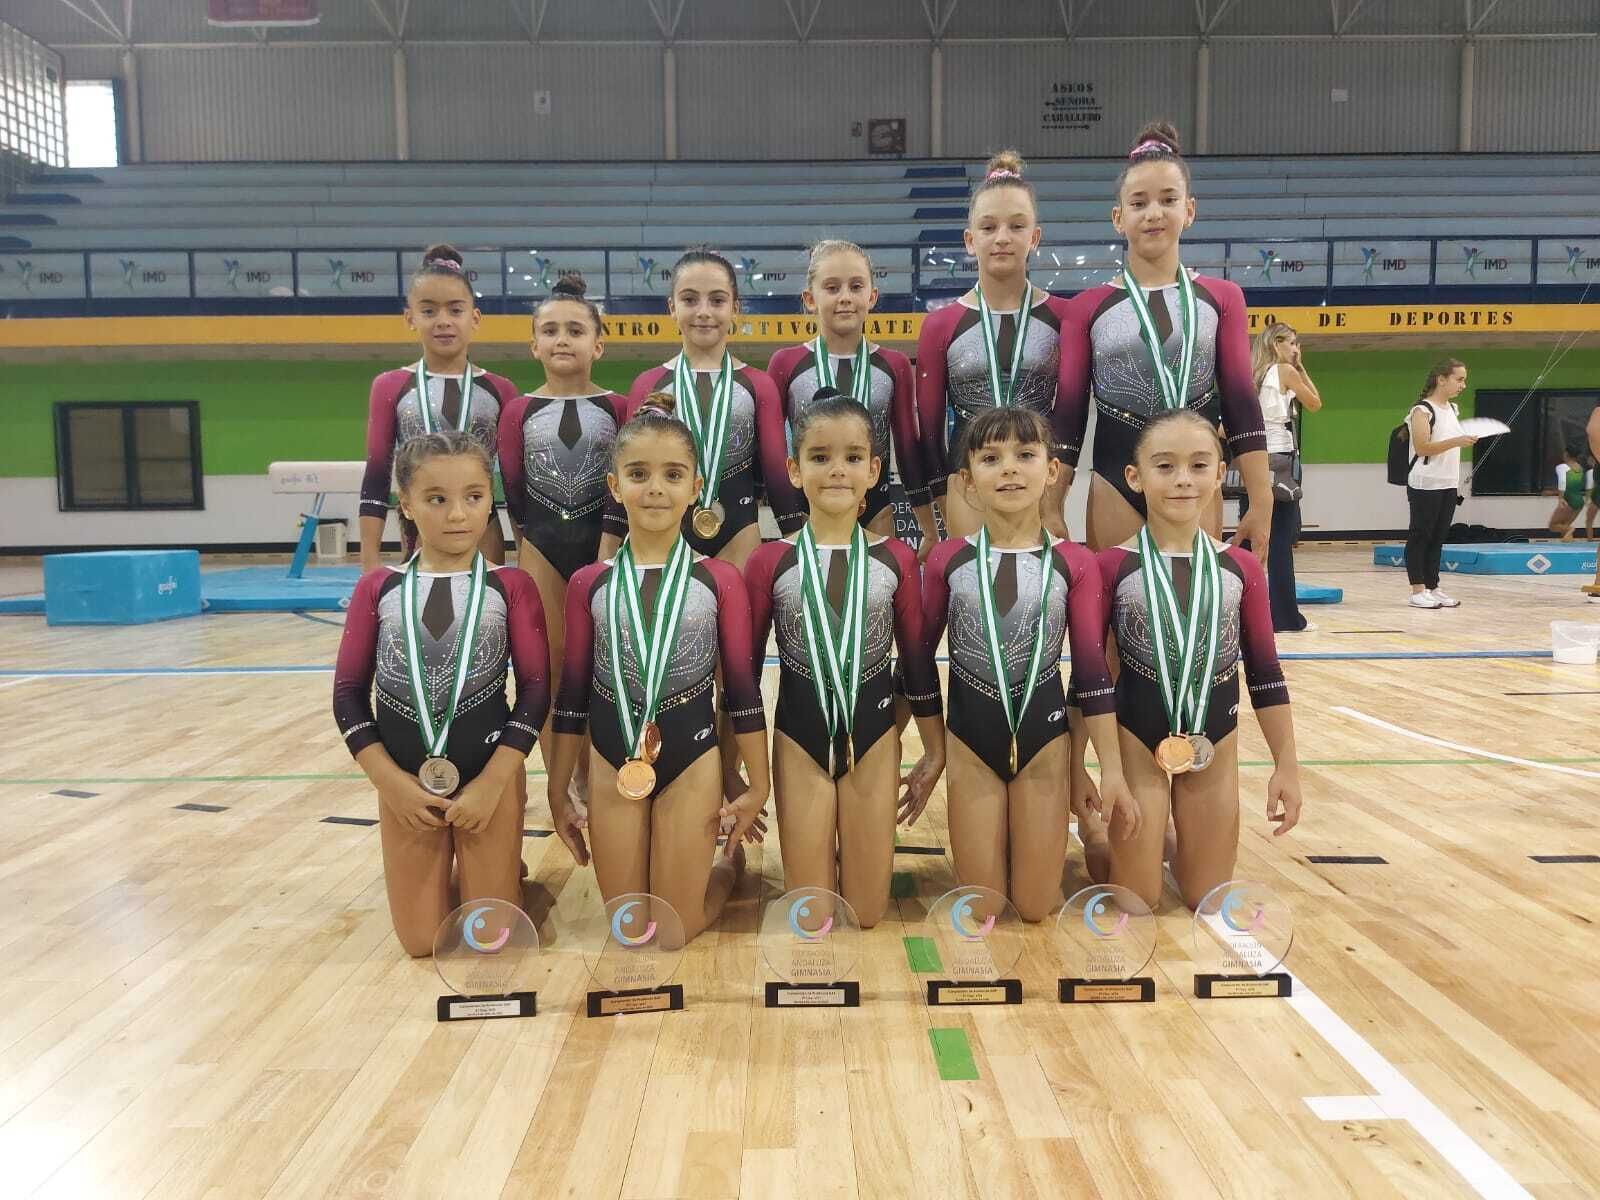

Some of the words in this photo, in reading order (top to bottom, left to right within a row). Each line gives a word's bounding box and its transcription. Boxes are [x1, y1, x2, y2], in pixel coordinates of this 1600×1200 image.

[1052, 83, 1094, 93] ASEOS
[1280, 261, 1304, 273] IMD
[1382, 259, 1407, 272] IMD
[1484, 258, 1508, 271] IMD
[1586, 257, 1600, 270] IM
[39, 271, 63, 284] IMD
[142, 271, 167, 284] IMD
[246, 270, 271, 284] IMD
[350, 270, 375, 284] IMD
[600, 321, 660, 336] NTRO
[861, 319, 913, 334] ATE
[1318, 312, 1347, 328] DE
[1390, 311, 1514, 326] DEPORTES
[1222, 960, 1263, 969] GIMNASIA
[791, 968, 832, 977] GIMNASIA
